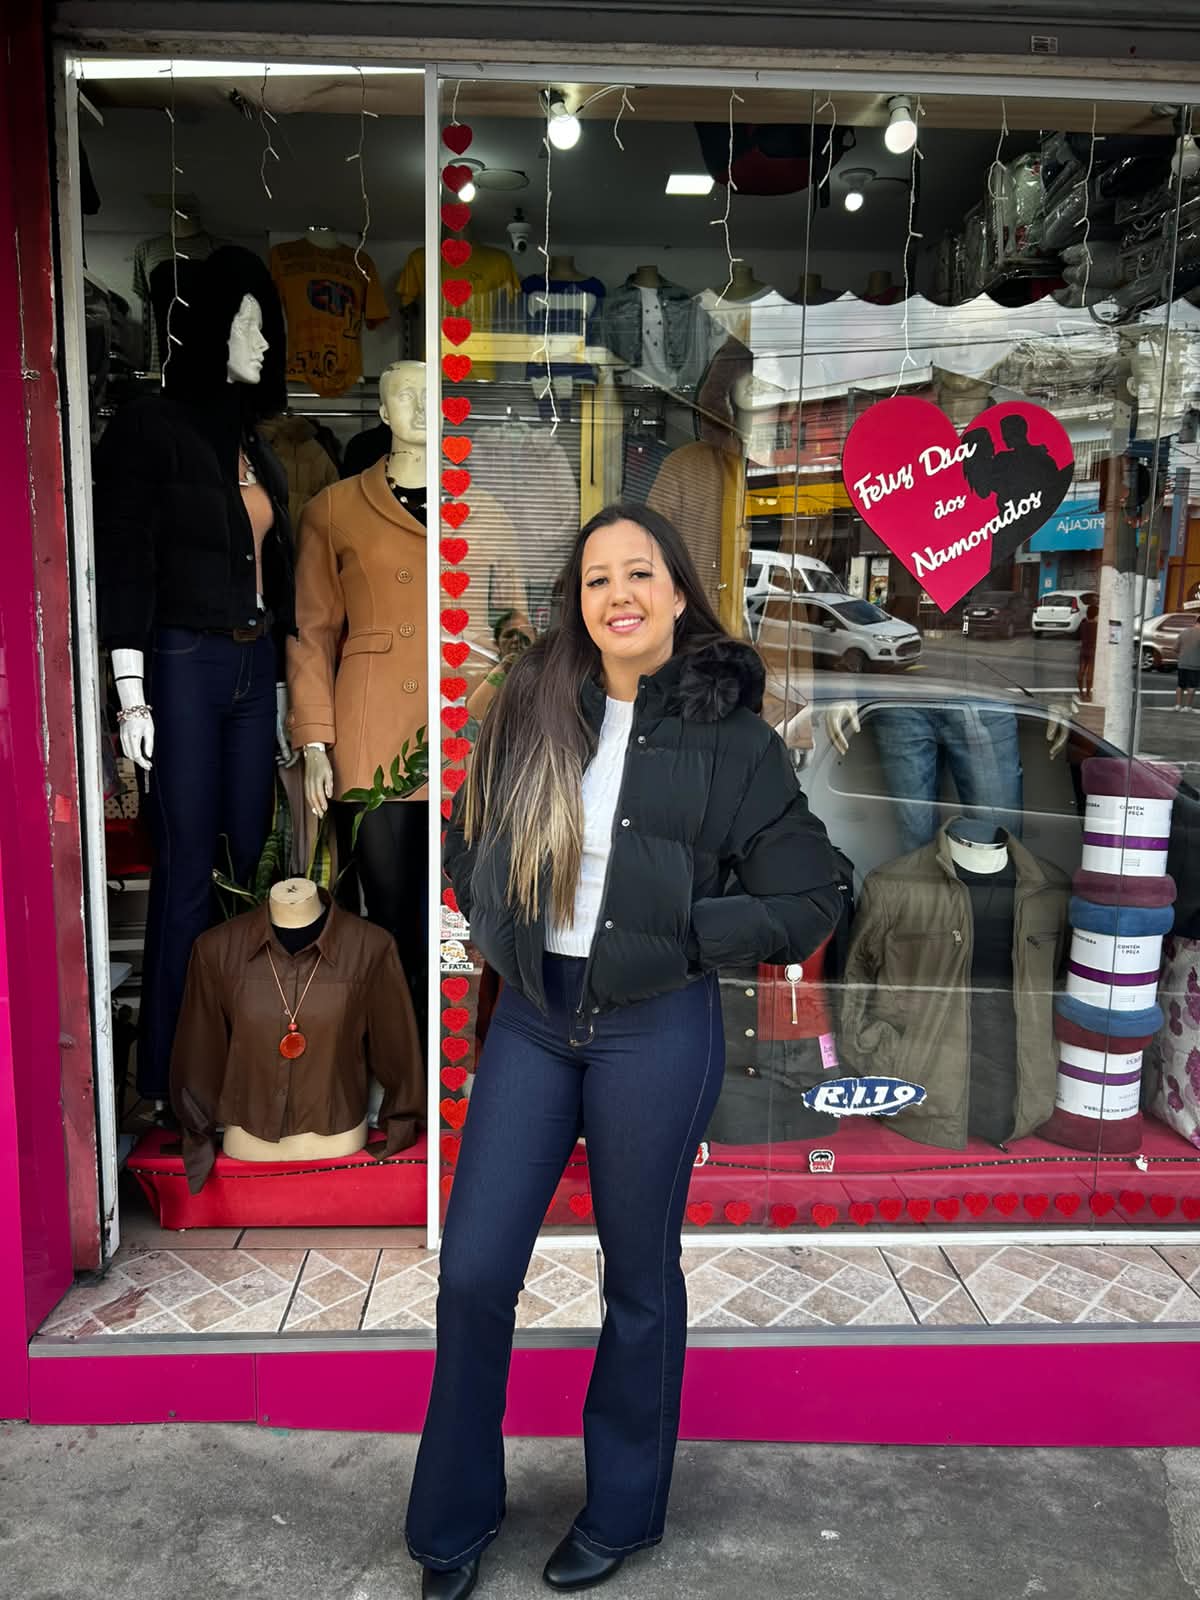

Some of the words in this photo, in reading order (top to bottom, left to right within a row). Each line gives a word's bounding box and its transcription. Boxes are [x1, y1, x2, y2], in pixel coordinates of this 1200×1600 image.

[853, 463, 914, 510] Feliz
[918, 442, 977, 476] Dia
[934, 495, 967, 519] dos
[911, 490, 1042, 578] Namorados
